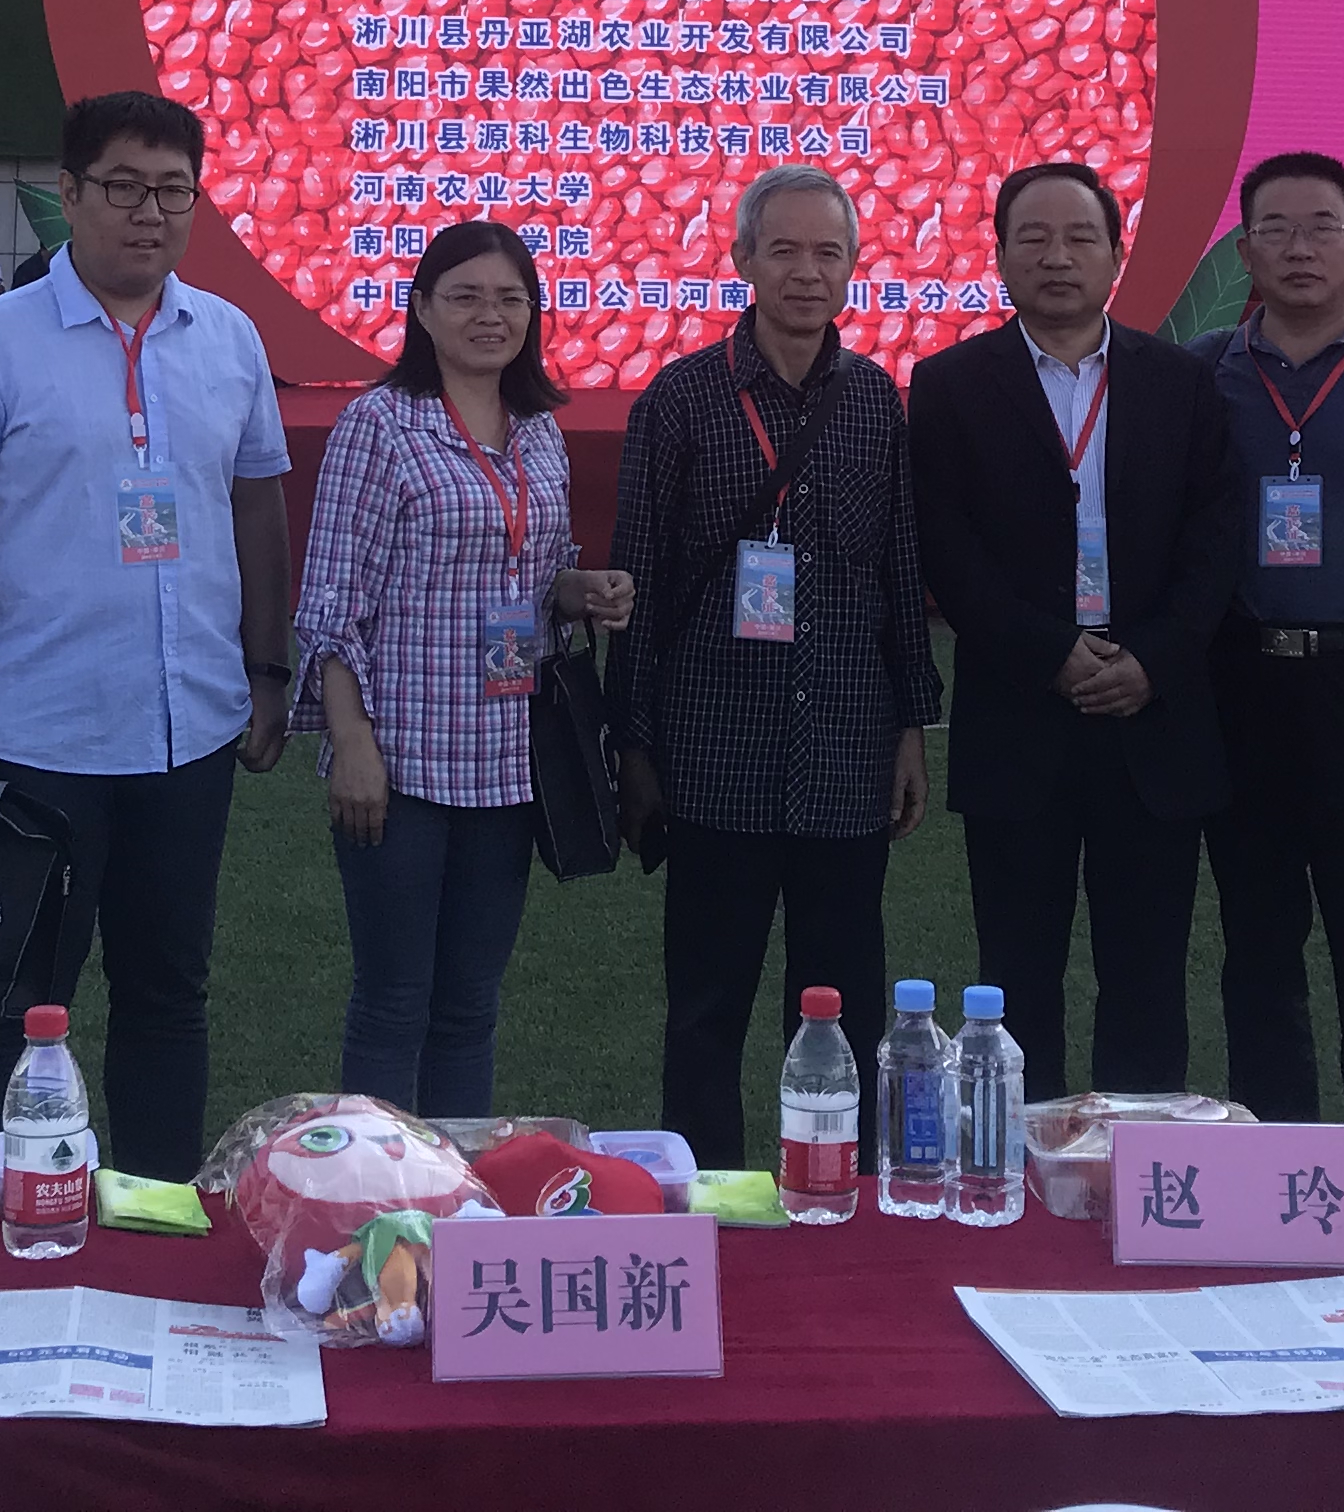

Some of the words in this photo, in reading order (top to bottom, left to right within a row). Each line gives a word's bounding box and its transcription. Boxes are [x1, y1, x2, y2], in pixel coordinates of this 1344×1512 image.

[355, 17, 912, 55] 淅川县丹亚湖农业开发有限公司
[353, 68, 950, 107] 南阳市果然出色生态林业有限公司
[352, 120, 872, 157] 淅川县源科生物科技有限公司
[352, 172, 592, 207] 河南农业大学
[352, 225, 592, 258] 南阳学院
[35, 1177, 83, 1198] 农夫山泉
[461, 1253, 689, 1338] 吴国新
